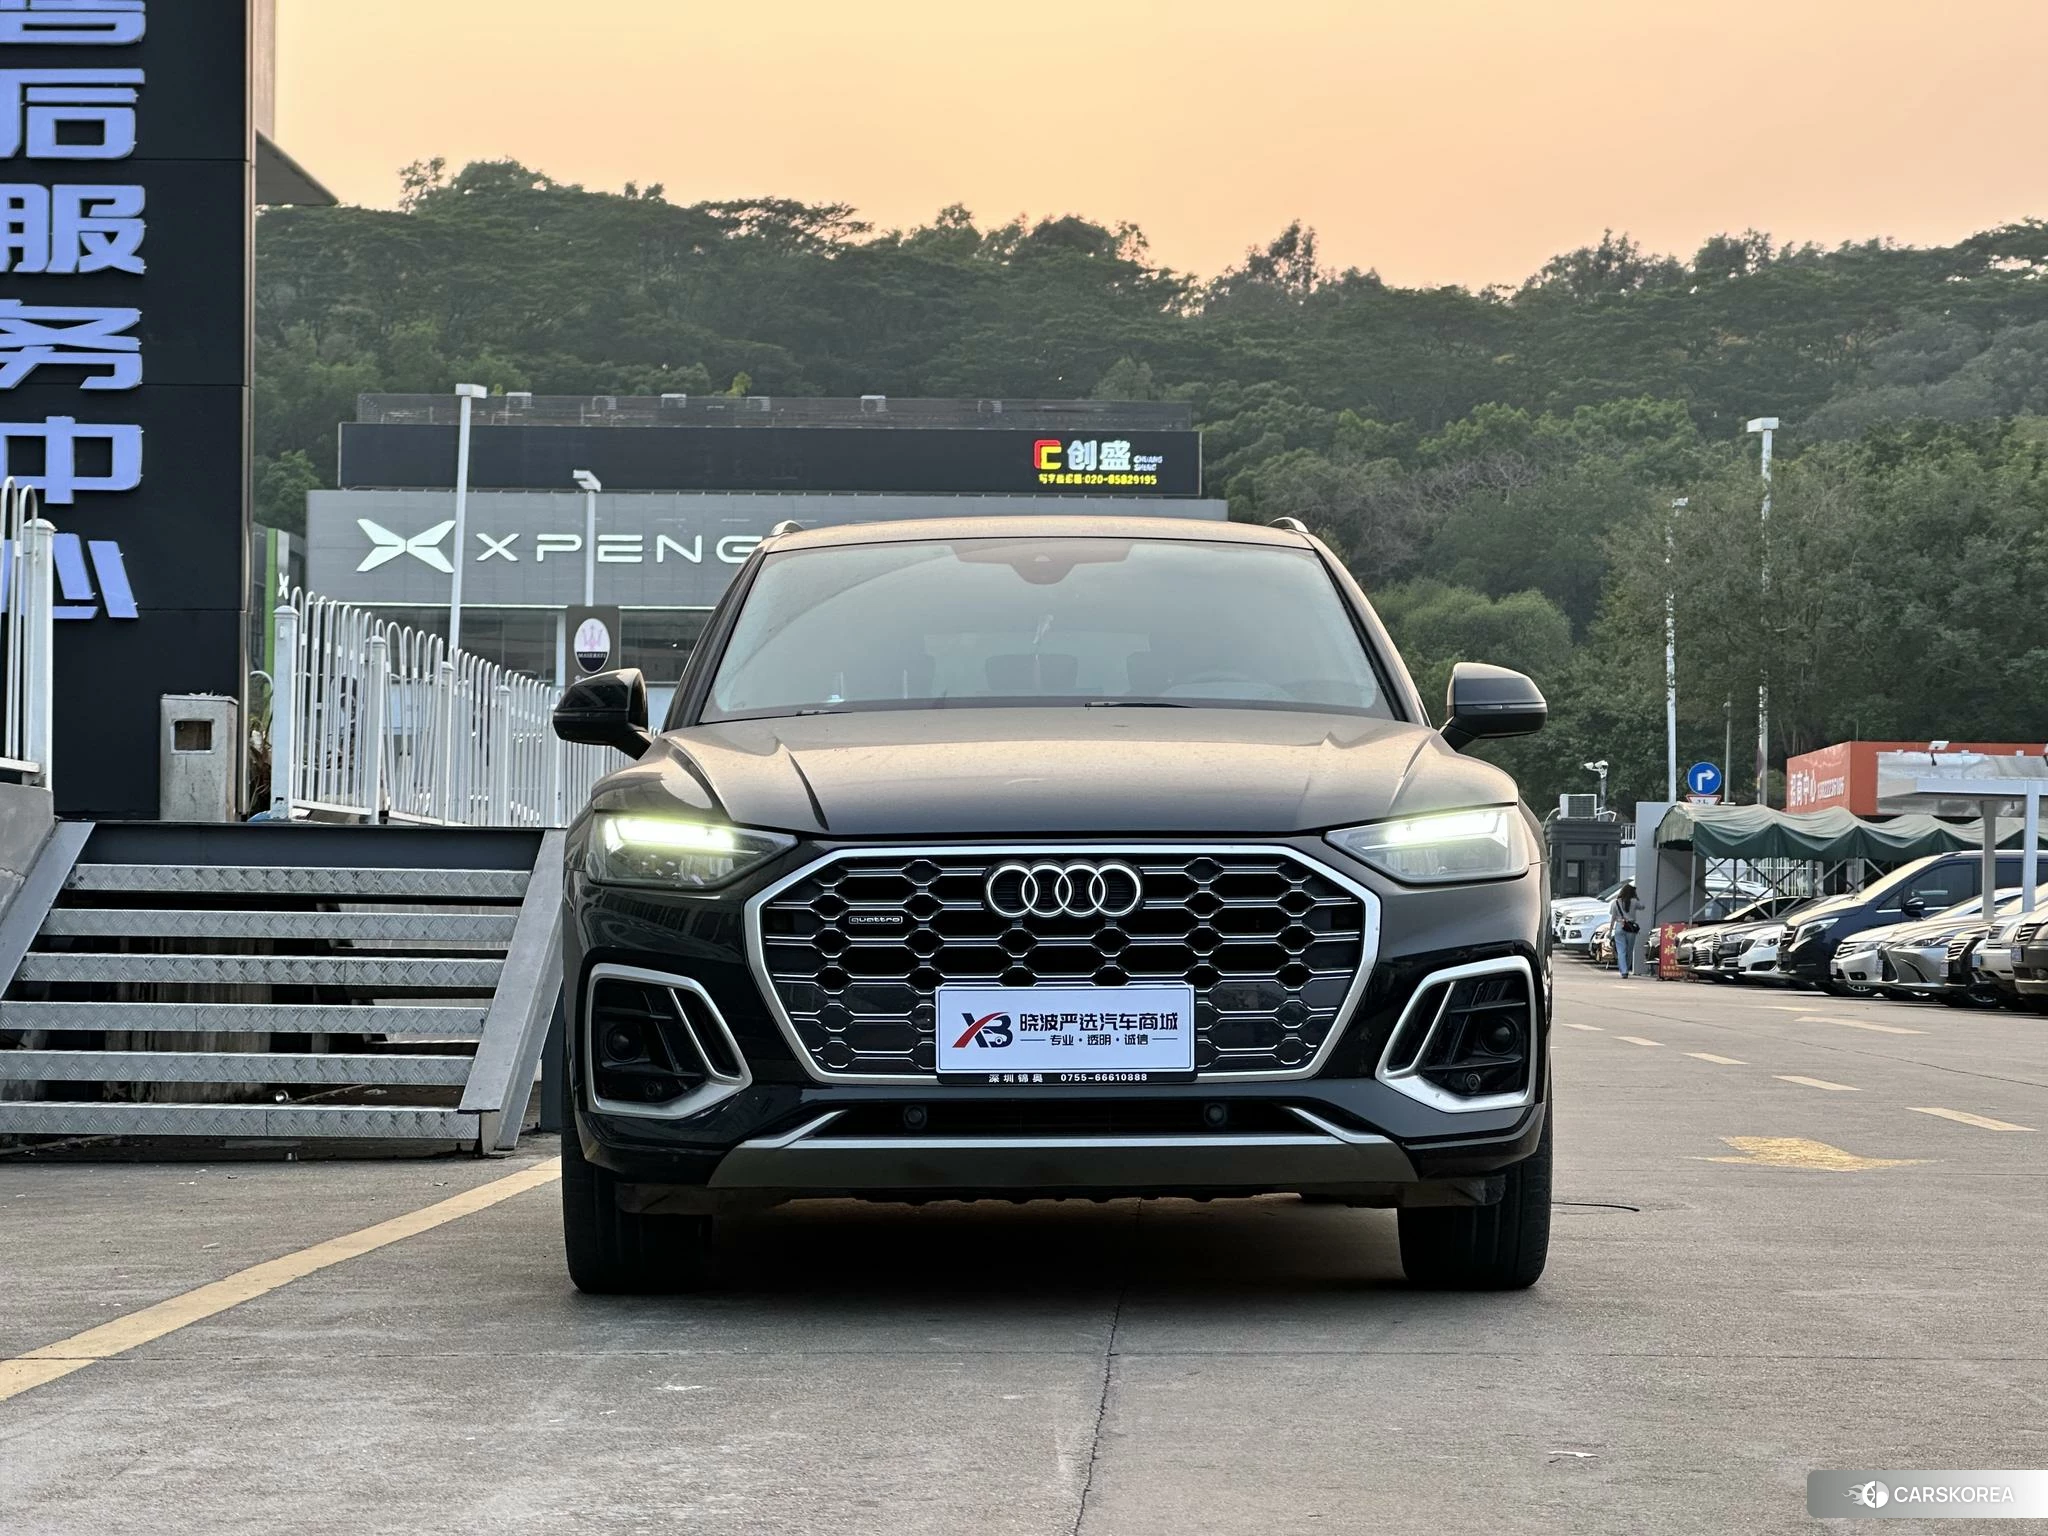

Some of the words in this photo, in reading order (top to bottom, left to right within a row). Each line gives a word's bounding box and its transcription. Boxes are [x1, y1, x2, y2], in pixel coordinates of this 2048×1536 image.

[1067, 440, 1131, 471] 创盛
[476, 533, 762, 563] XPENG
[1019, 1013, 1178, 1032] 晓波严选汽车商城
[1060, 1073, 1148, 1082] 0755-66610888
